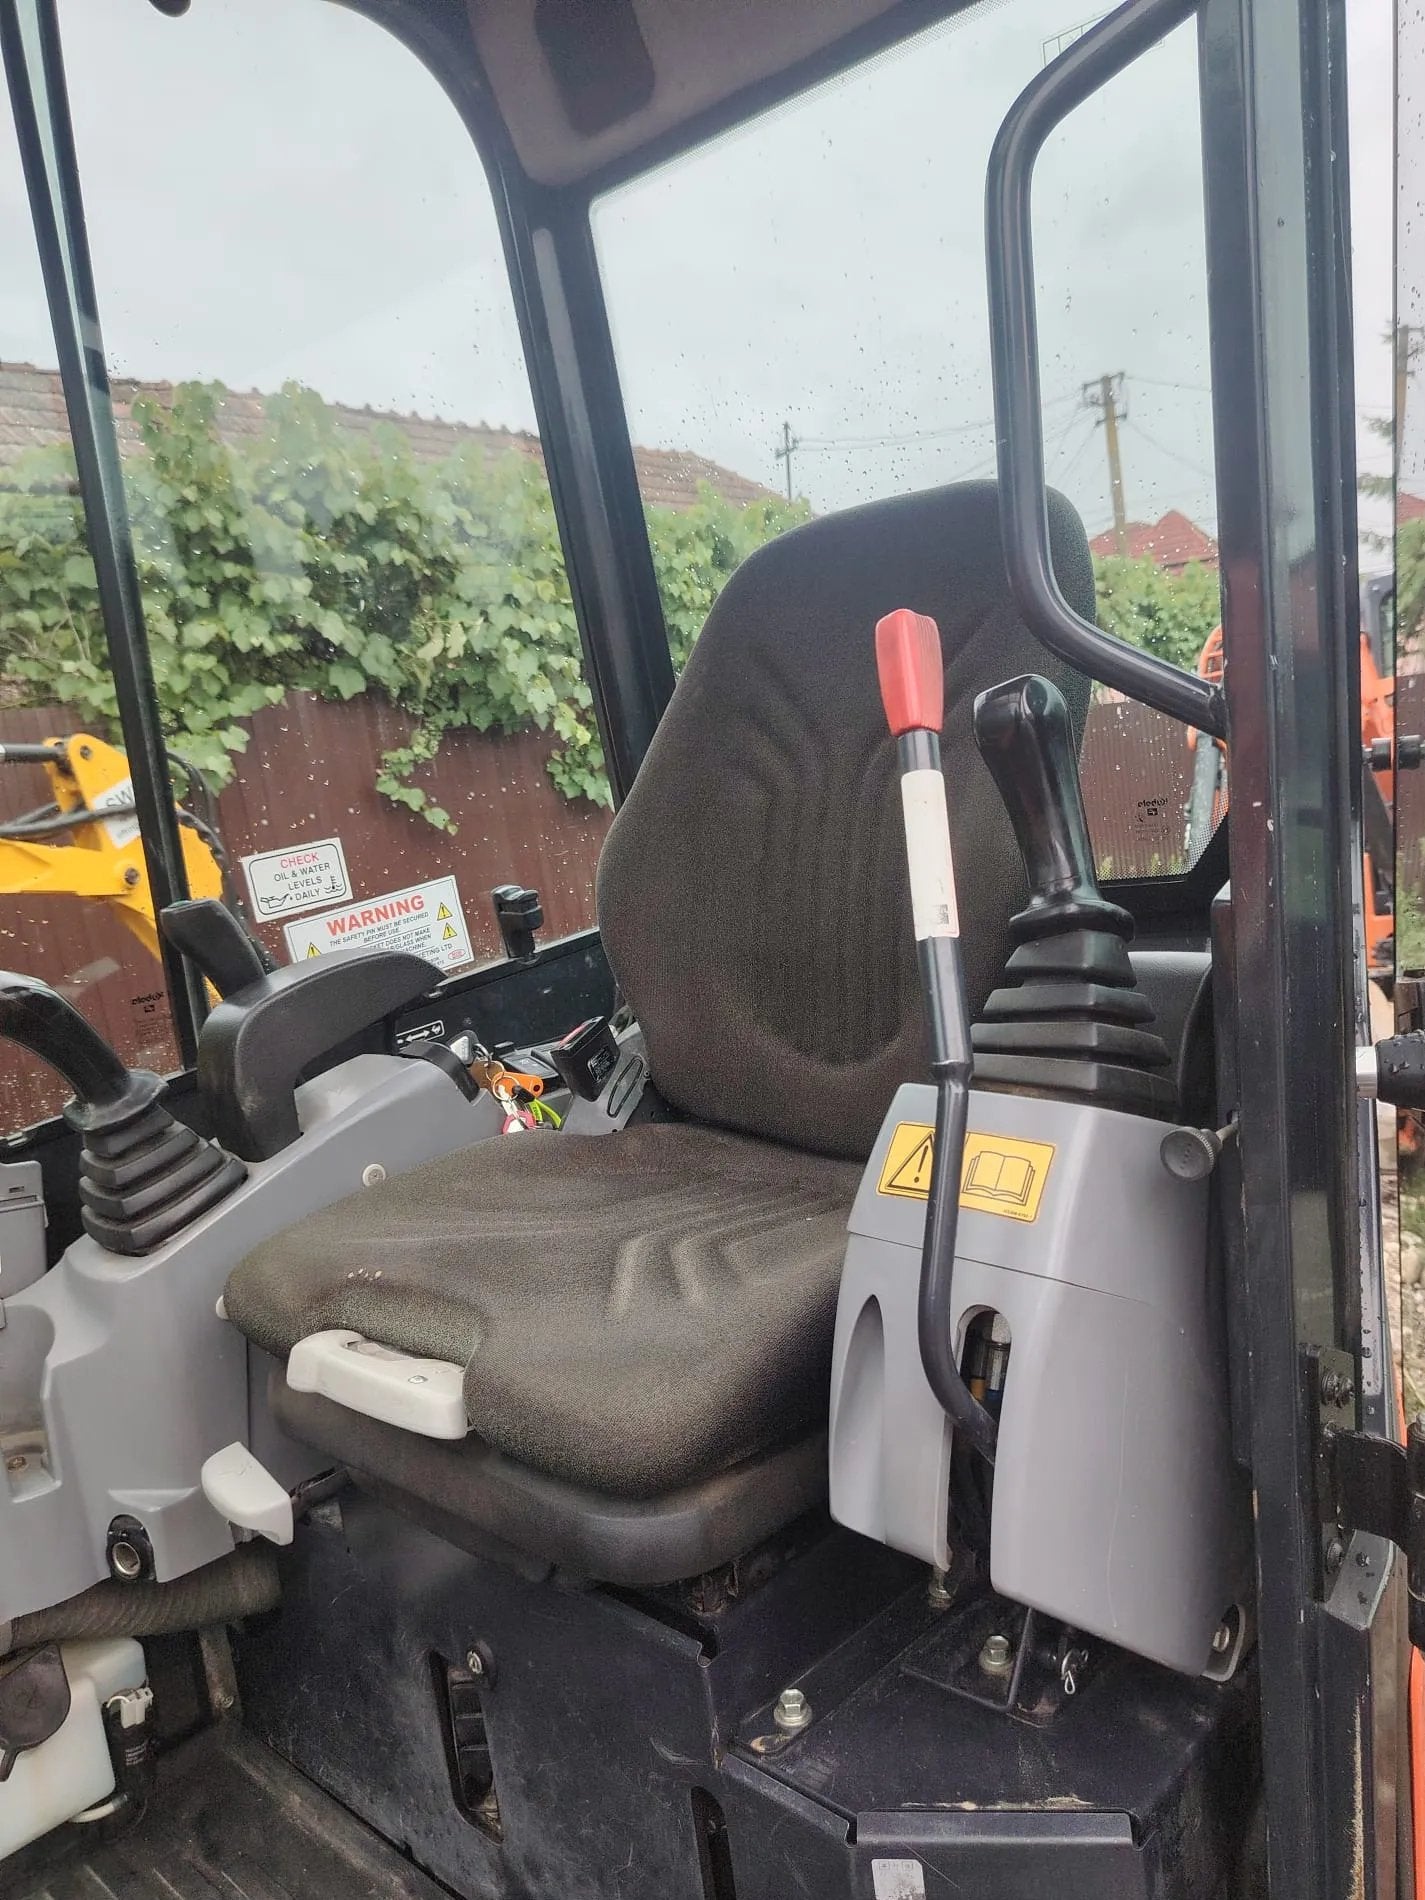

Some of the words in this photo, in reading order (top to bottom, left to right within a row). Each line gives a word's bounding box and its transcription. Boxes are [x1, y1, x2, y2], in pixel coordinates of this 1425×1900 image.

[280, 852, 320, 869] CHECK
[273, 871, 290, 882] OIL
[291, 869, 298, 878] &
[299, 862, 331, 876] WATER
[288, 875, 323, 891] LEVELS
[295, 888, 321, 901] DAILY
[327, 895, 425, 936] WARNING
[329, 939, 341, 948] THE
[342, 931, 366, 945] SAFETY
[366, 928, 376, 937] PIN
[377, 922, 393, 933] MUST
[393, 918, 402, 927] BE
[403, 912, 429, 923] SECURED
[363, 932, 387, 944] BEFORE
[385, 936, 402, 947] DOES
[402, 932, 415, 942] NOT
[415, 927, 430, 936] MAKE
[395, 938, 414, 951] GLASS
[415, 932, 432, 943] WHEN
